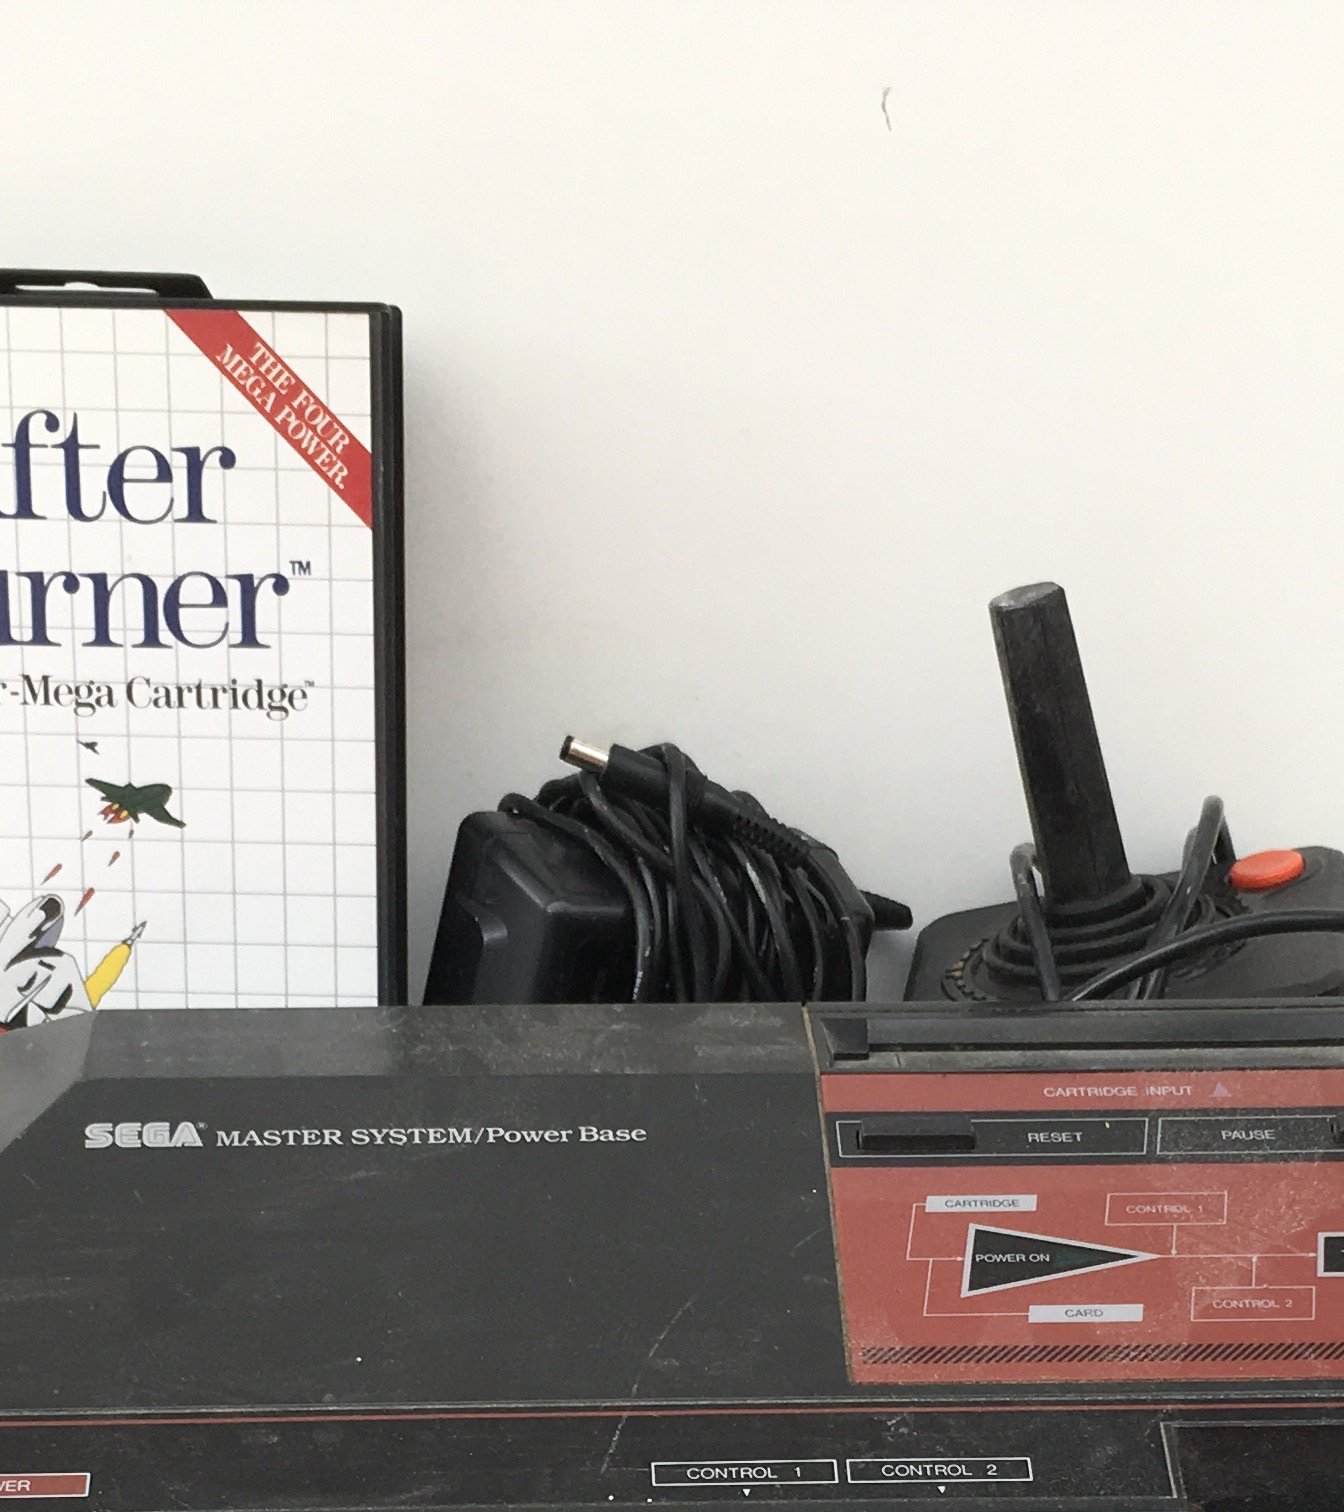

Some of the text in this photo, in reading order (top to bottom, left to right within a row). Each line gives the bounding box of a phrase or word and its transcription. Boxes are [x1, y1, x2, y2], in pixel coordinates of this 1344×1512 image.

[216, 344, 276, 409] MEGA
[252, 341, 350, 454] THE FOUR
[126, 678, 308, 720] Cartridge
[1043, 1084, 1193, 1099] CARTRIDGE INPUT
[84, 1121, 205, 1149] SEGA
[216, 1129, 343, 1149] MASTER
[579, 1126, 647, 1143] Base
[1027, 1130, 1084, 1144] RESET
[1221, 1128, 1276, 1142] PAUSE
[944, 1198, 1021, 1209] CARTRIDGE
[1125, 1202, 1190, 1214] CONTROL
[975, 1251, 1050, 1264] POWER ON
[1212, 1298, 1294, 1310] CONTROL 2
[1064, 1307, 1104, 1318] CARD
[686, 1466, 777, 1480] CONTROL
[881, 1463, 998, 1478] CONTROL 2
